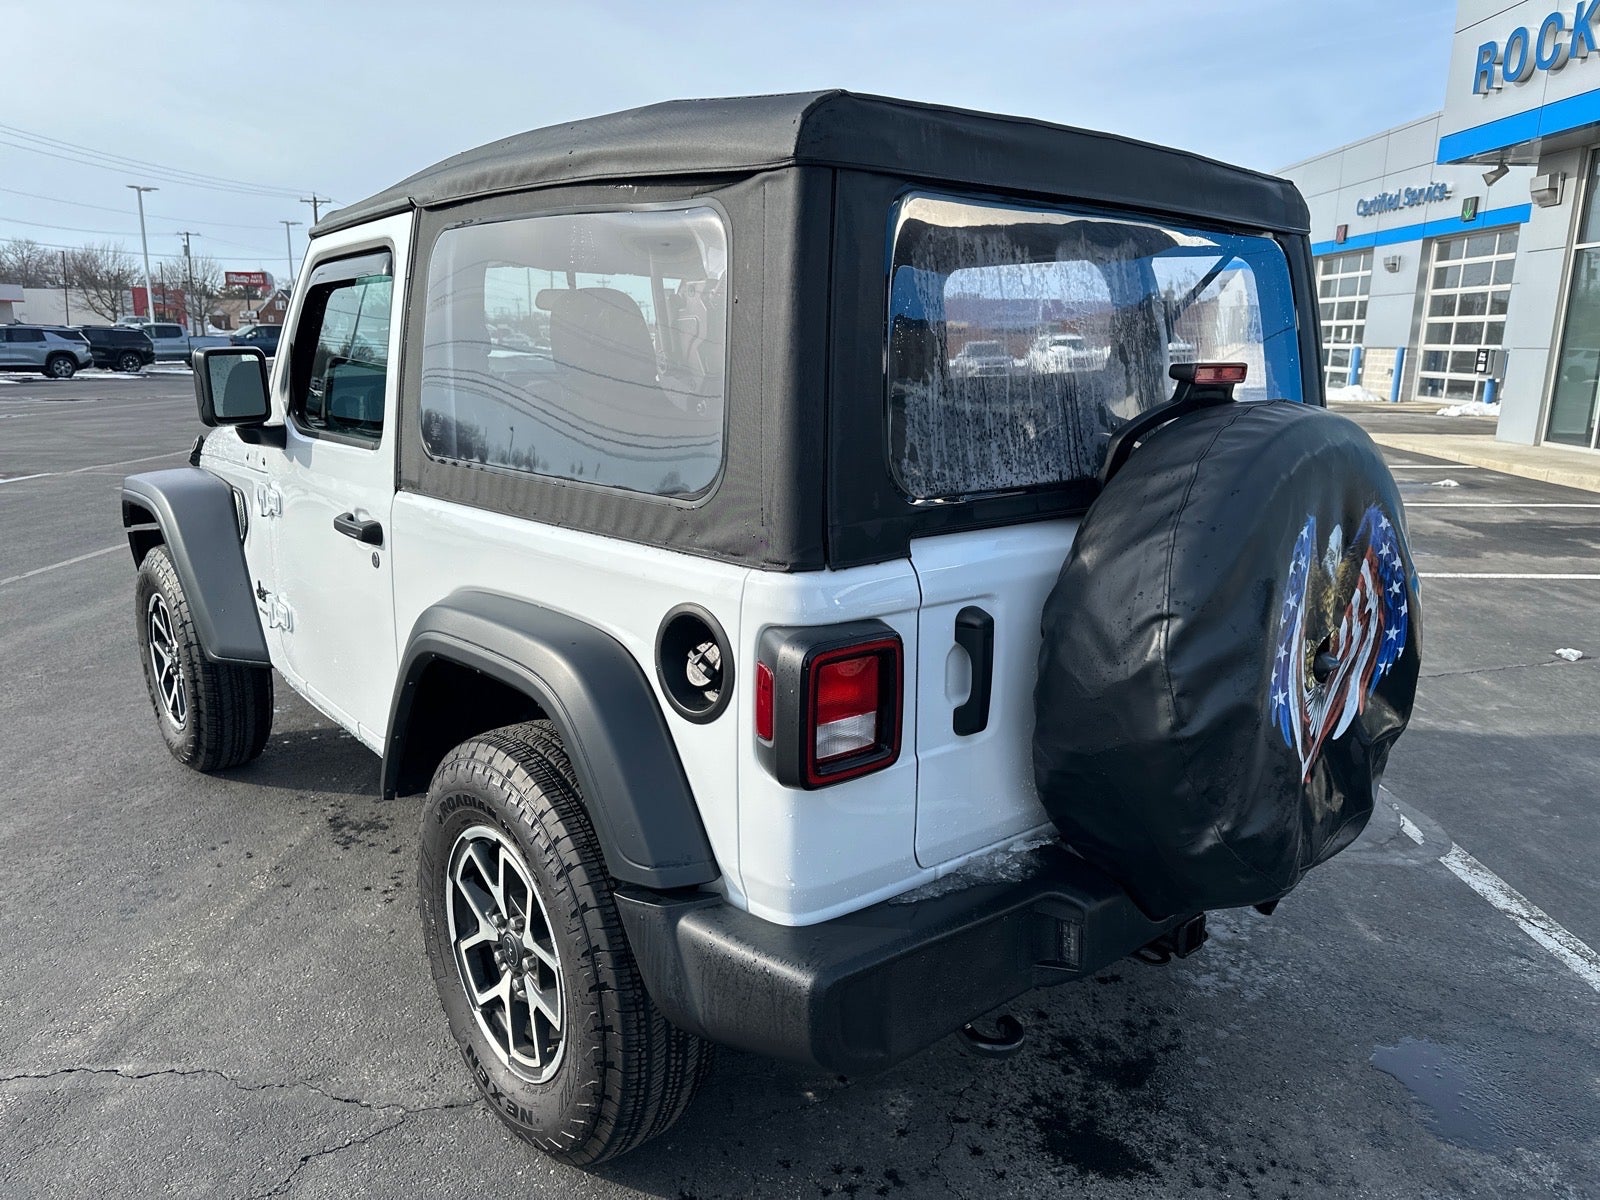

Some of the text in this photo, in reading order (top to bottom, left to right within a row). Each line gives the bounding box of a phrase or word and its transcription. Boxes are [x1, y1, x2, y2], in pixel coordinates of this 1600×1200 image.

[1357, 182, 1447, 216] Certified Service
[466, 1043, 534, 1126] NEXEN
